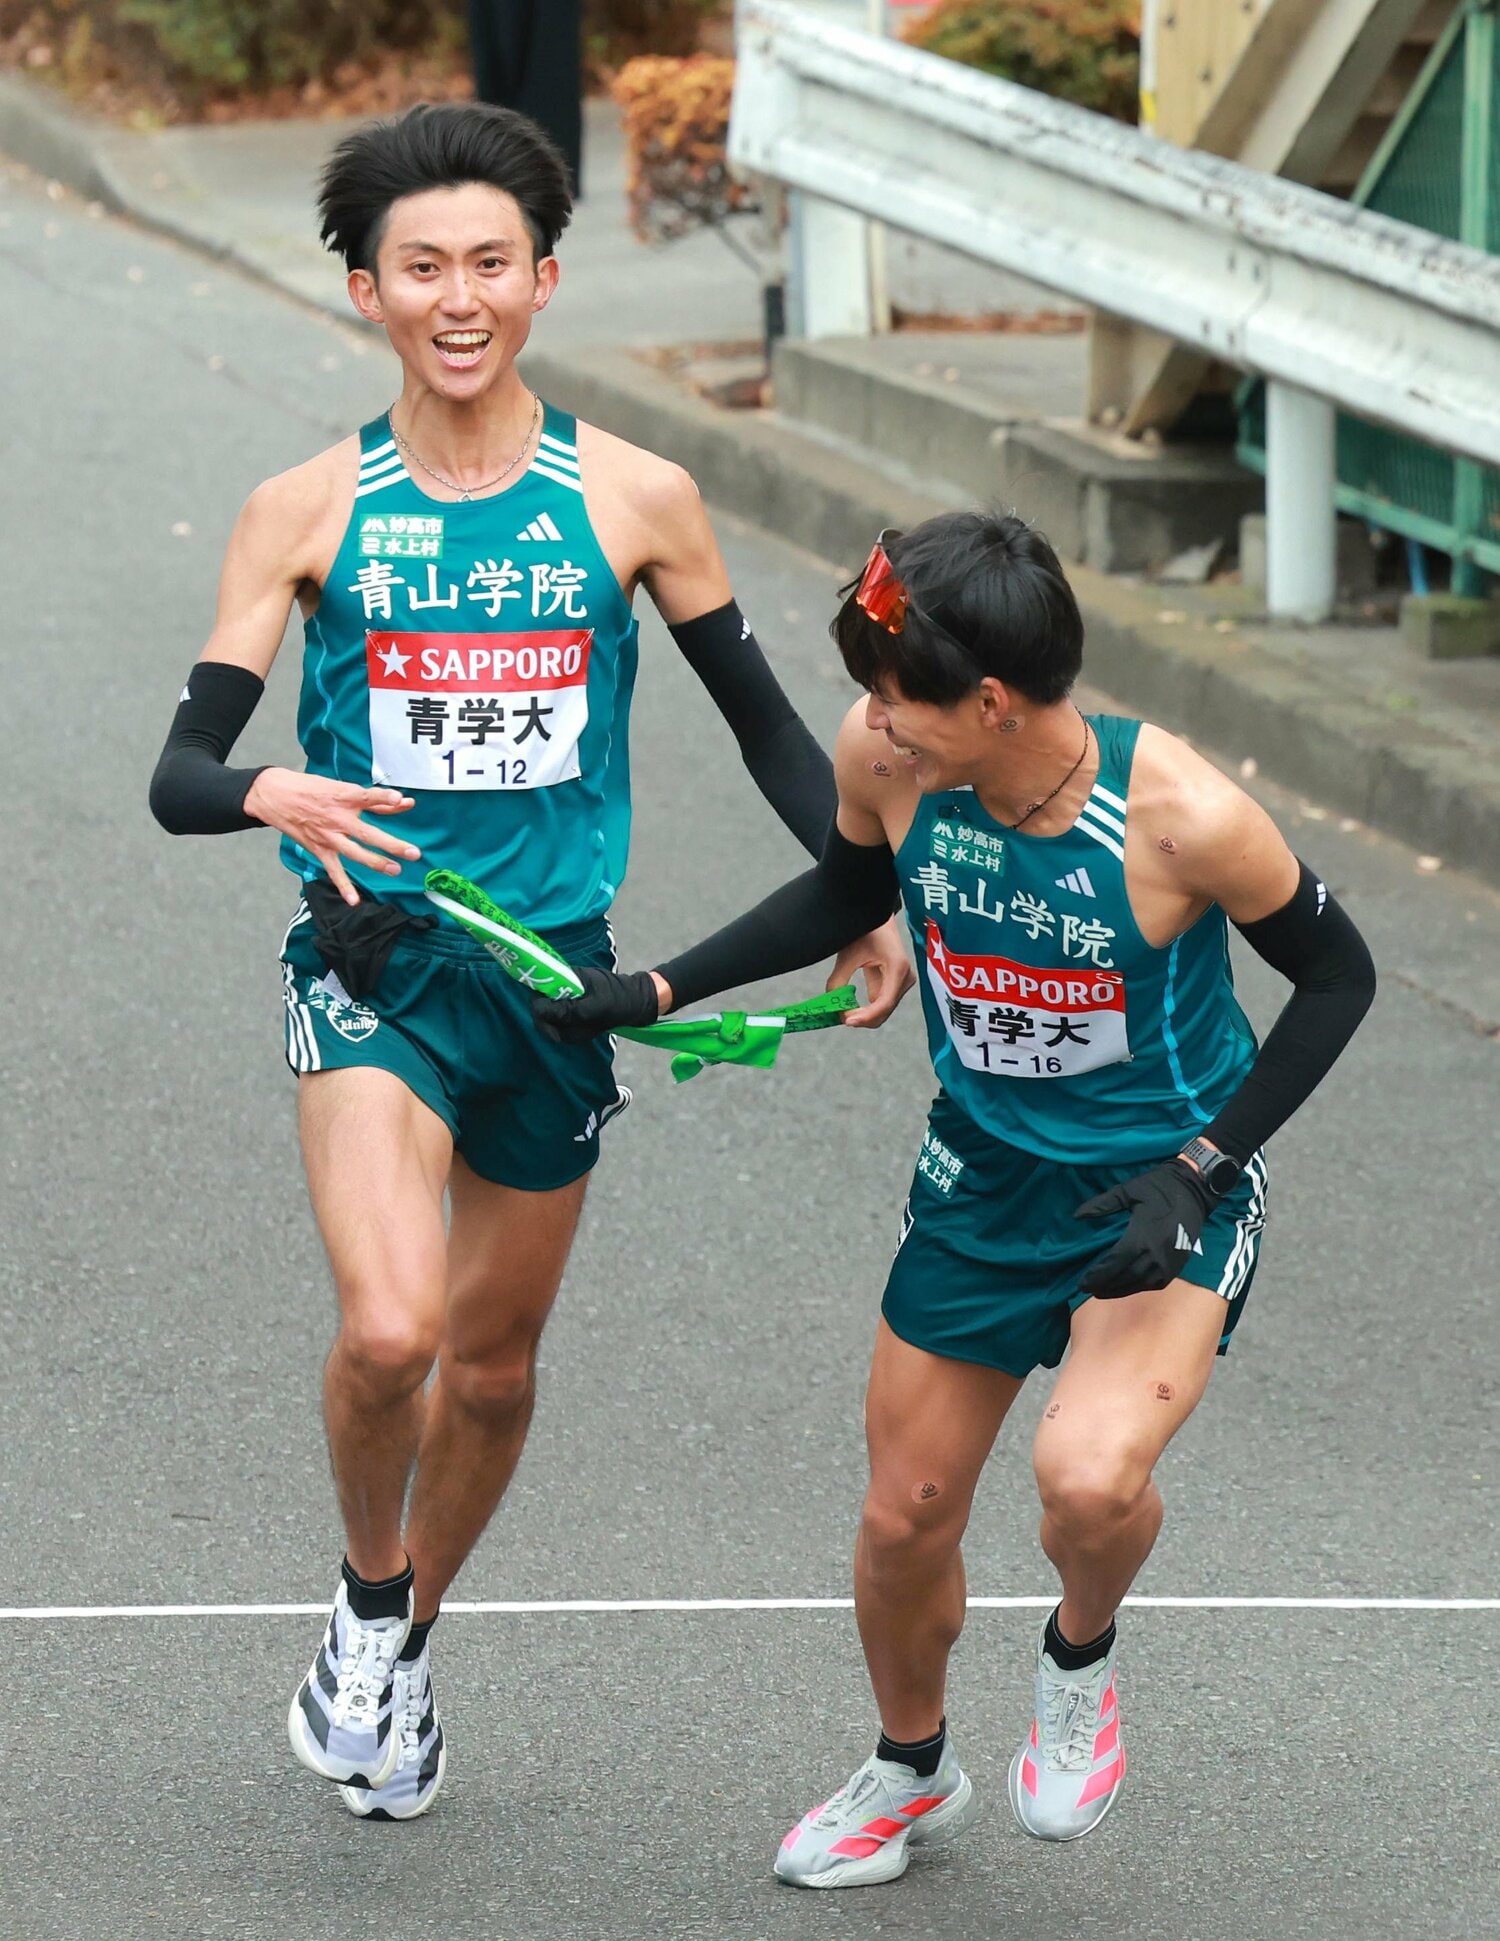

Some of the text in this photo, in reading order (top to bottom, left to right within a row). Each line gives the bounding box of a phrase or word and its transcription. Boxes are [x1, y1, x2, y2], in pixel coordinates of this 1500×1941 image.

[389, 516, 443, 535] 妙高市
[384, 537, 440, 556] 水上村
[347, 558, 588, 620] 青山学院
[420, 644, 582, 681] SAPPORO
[405, 696, 554, 745] 青学大
[957, 825, 1004, 853] 妙高市
[950, 845, 1001, 872] 水上村
[909, 860, 1116, 969] 青山学院
[949, 964, 1115, 1005] SAPPORO
[945, 992, 1091, 1047] 青学大
[918, 1156, 953, 1193] 水上村
[928, 1136, 964, 1176] 妙高市
